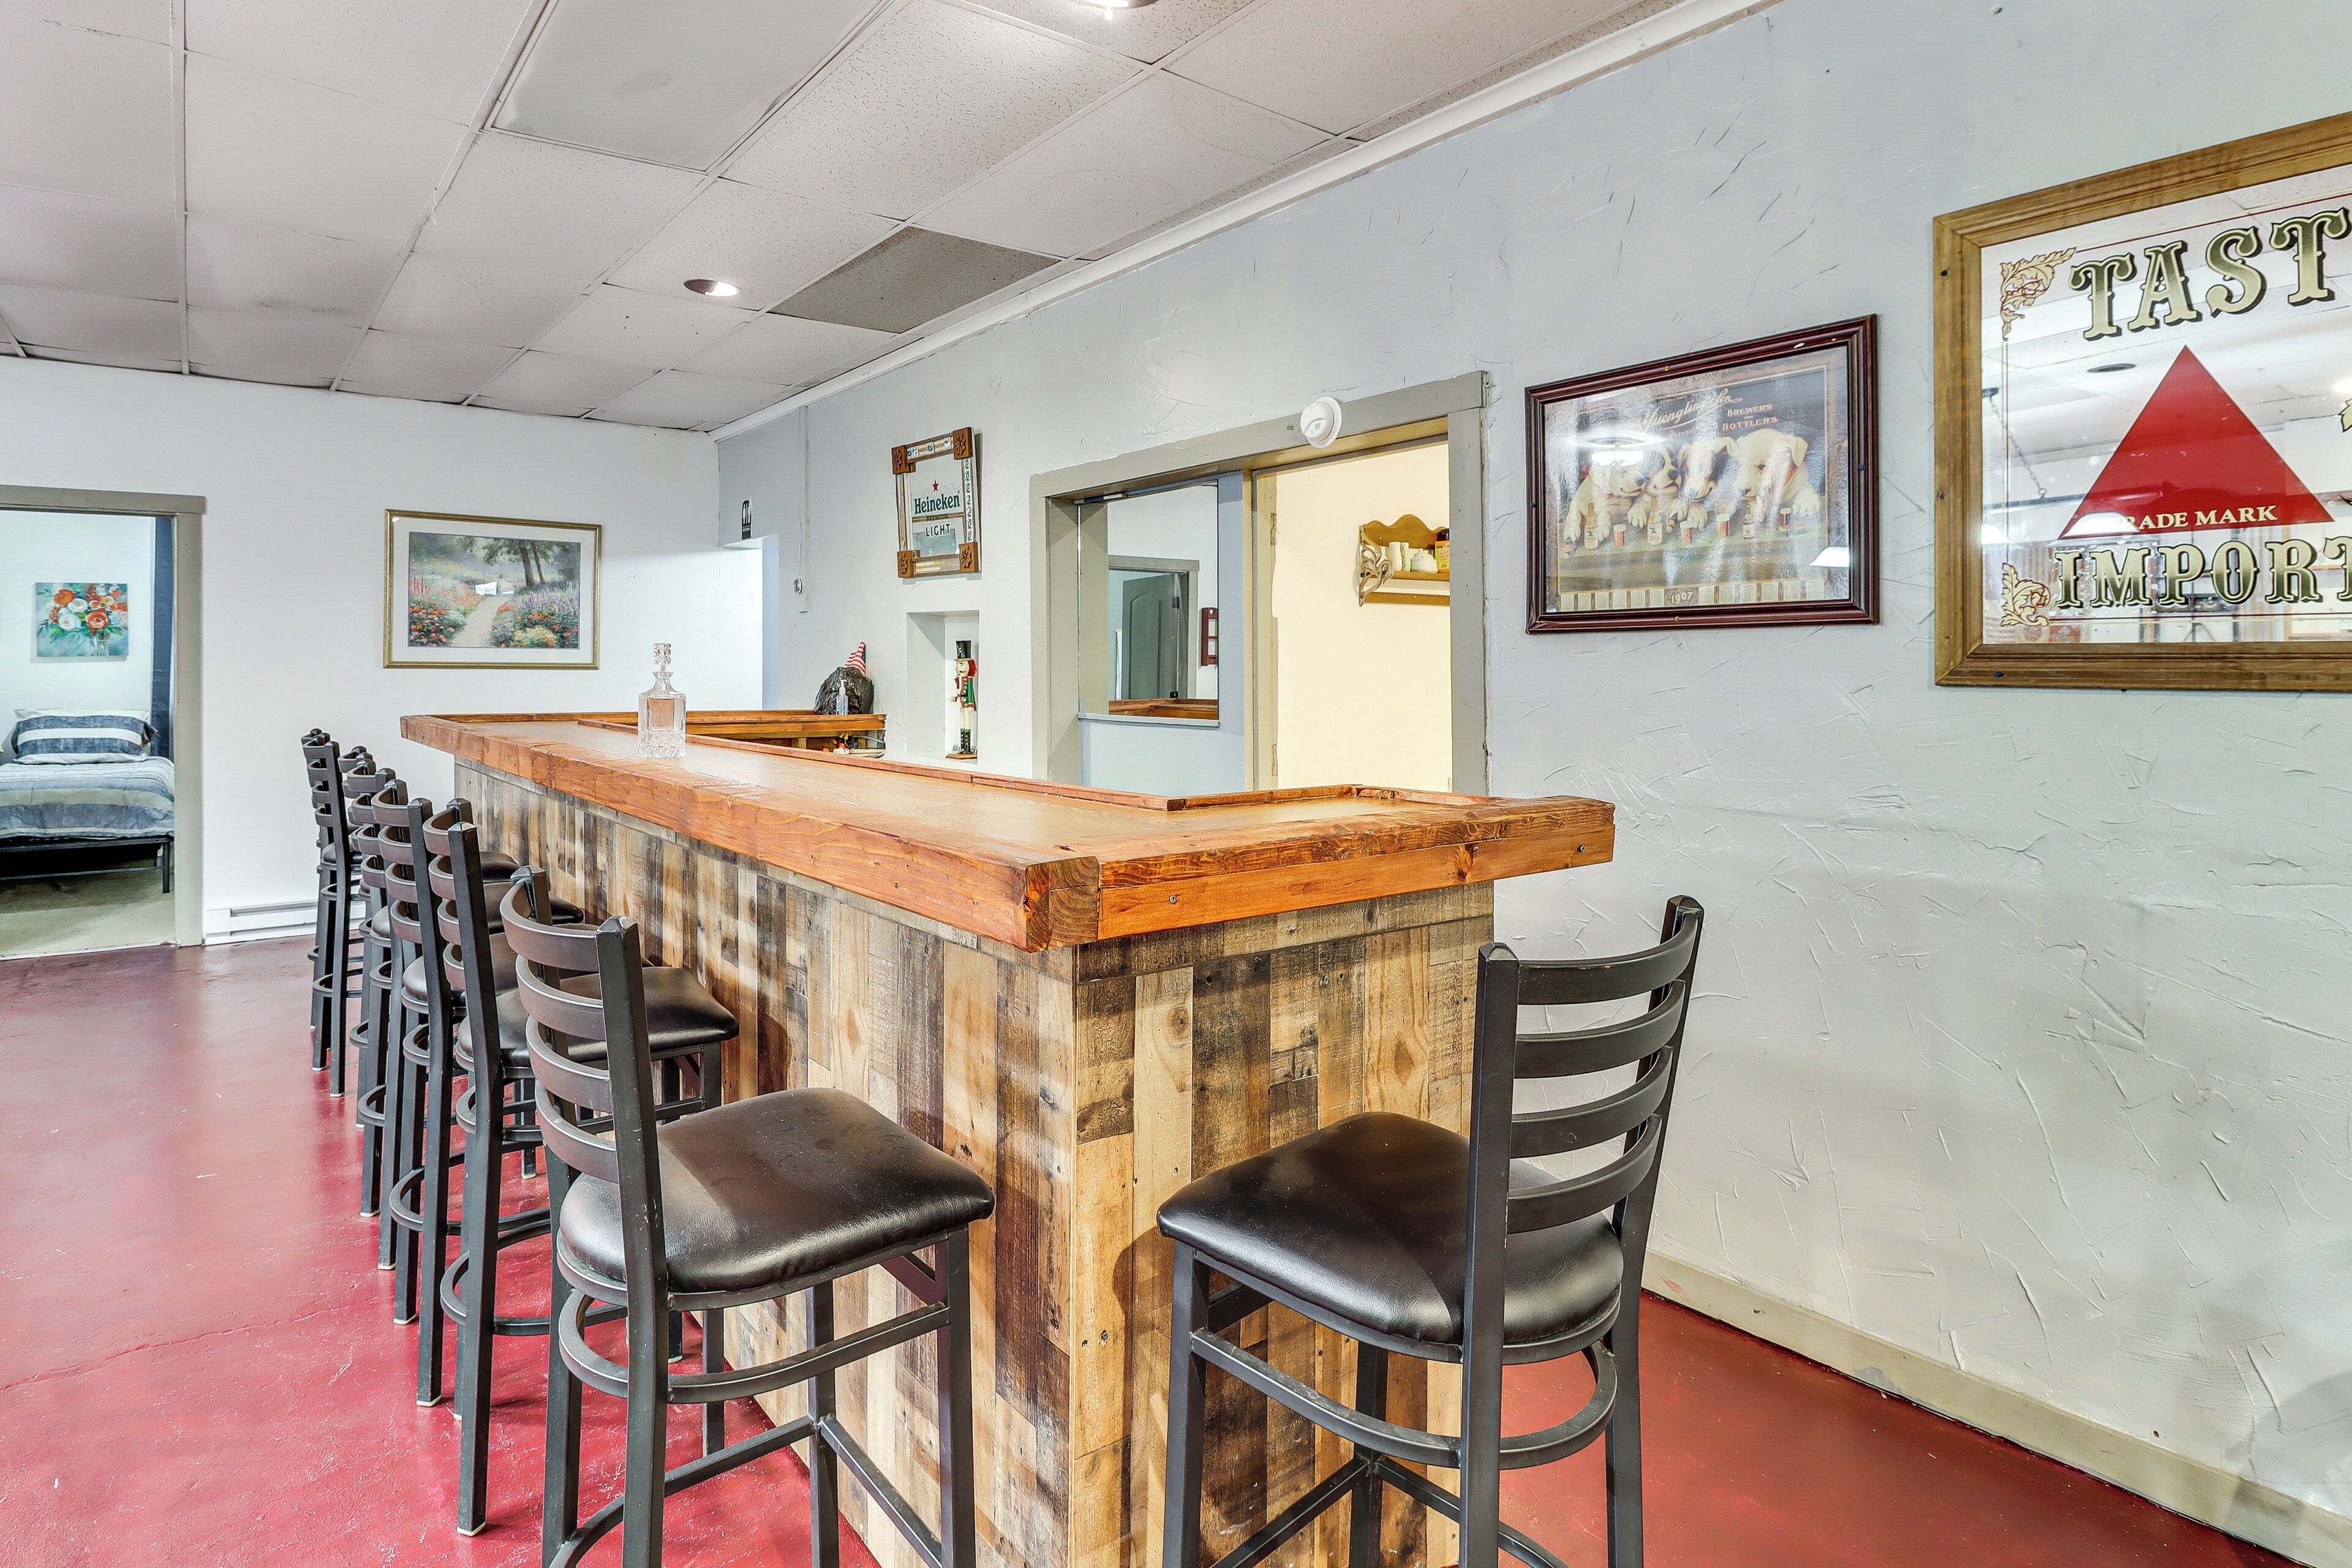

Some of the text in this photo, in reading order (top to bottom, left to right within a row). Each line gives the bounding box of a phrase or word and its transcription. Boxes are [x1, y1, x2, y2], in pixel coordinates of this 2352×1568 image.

[2068, 207, 2352, 341] TAST
[1727, 404, 1773, 417] BREWERS
[1722, 416, 1778, 431] BOTTLERS
[914, 494, 960, 514] Heineken
[2122, 505, 2278, 530] RADE MARK
[925, 523, 951, 537] LIGHT
[1671, 591, 1694, 605] 1907
